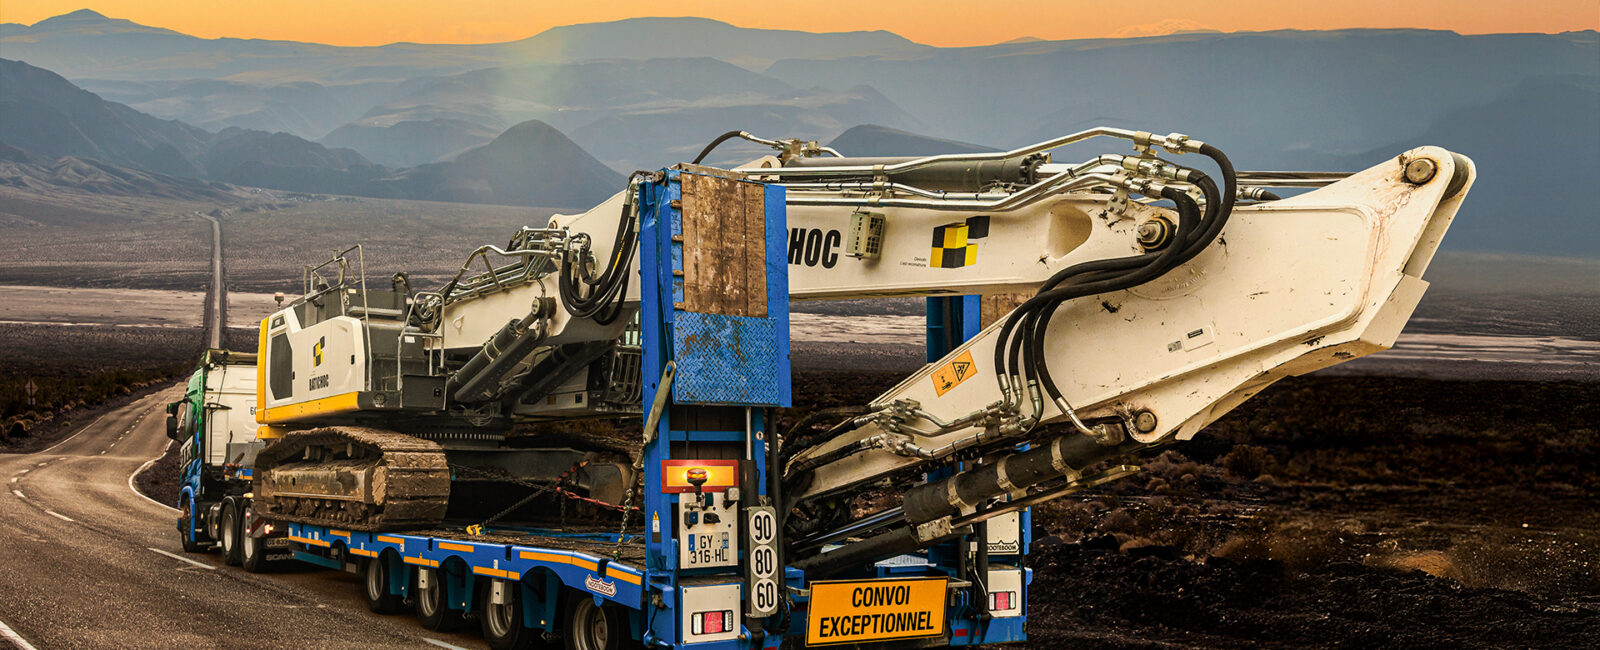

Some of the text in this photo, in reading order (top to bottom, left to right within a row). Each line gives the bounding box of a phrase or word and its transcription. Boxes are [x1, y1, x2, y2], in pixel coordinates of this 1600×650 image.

[787, 228, 841, 269] HOC
[754, 514, 772, 541] 90
[700, 535, 713, 549] GY
[755, 548, 772, 576] 80
[757, 581, 774, 609] 60
[852, 585, 911, 608] CONVOI
[819, 611, 934, 638] EXCEPTIONNEL
